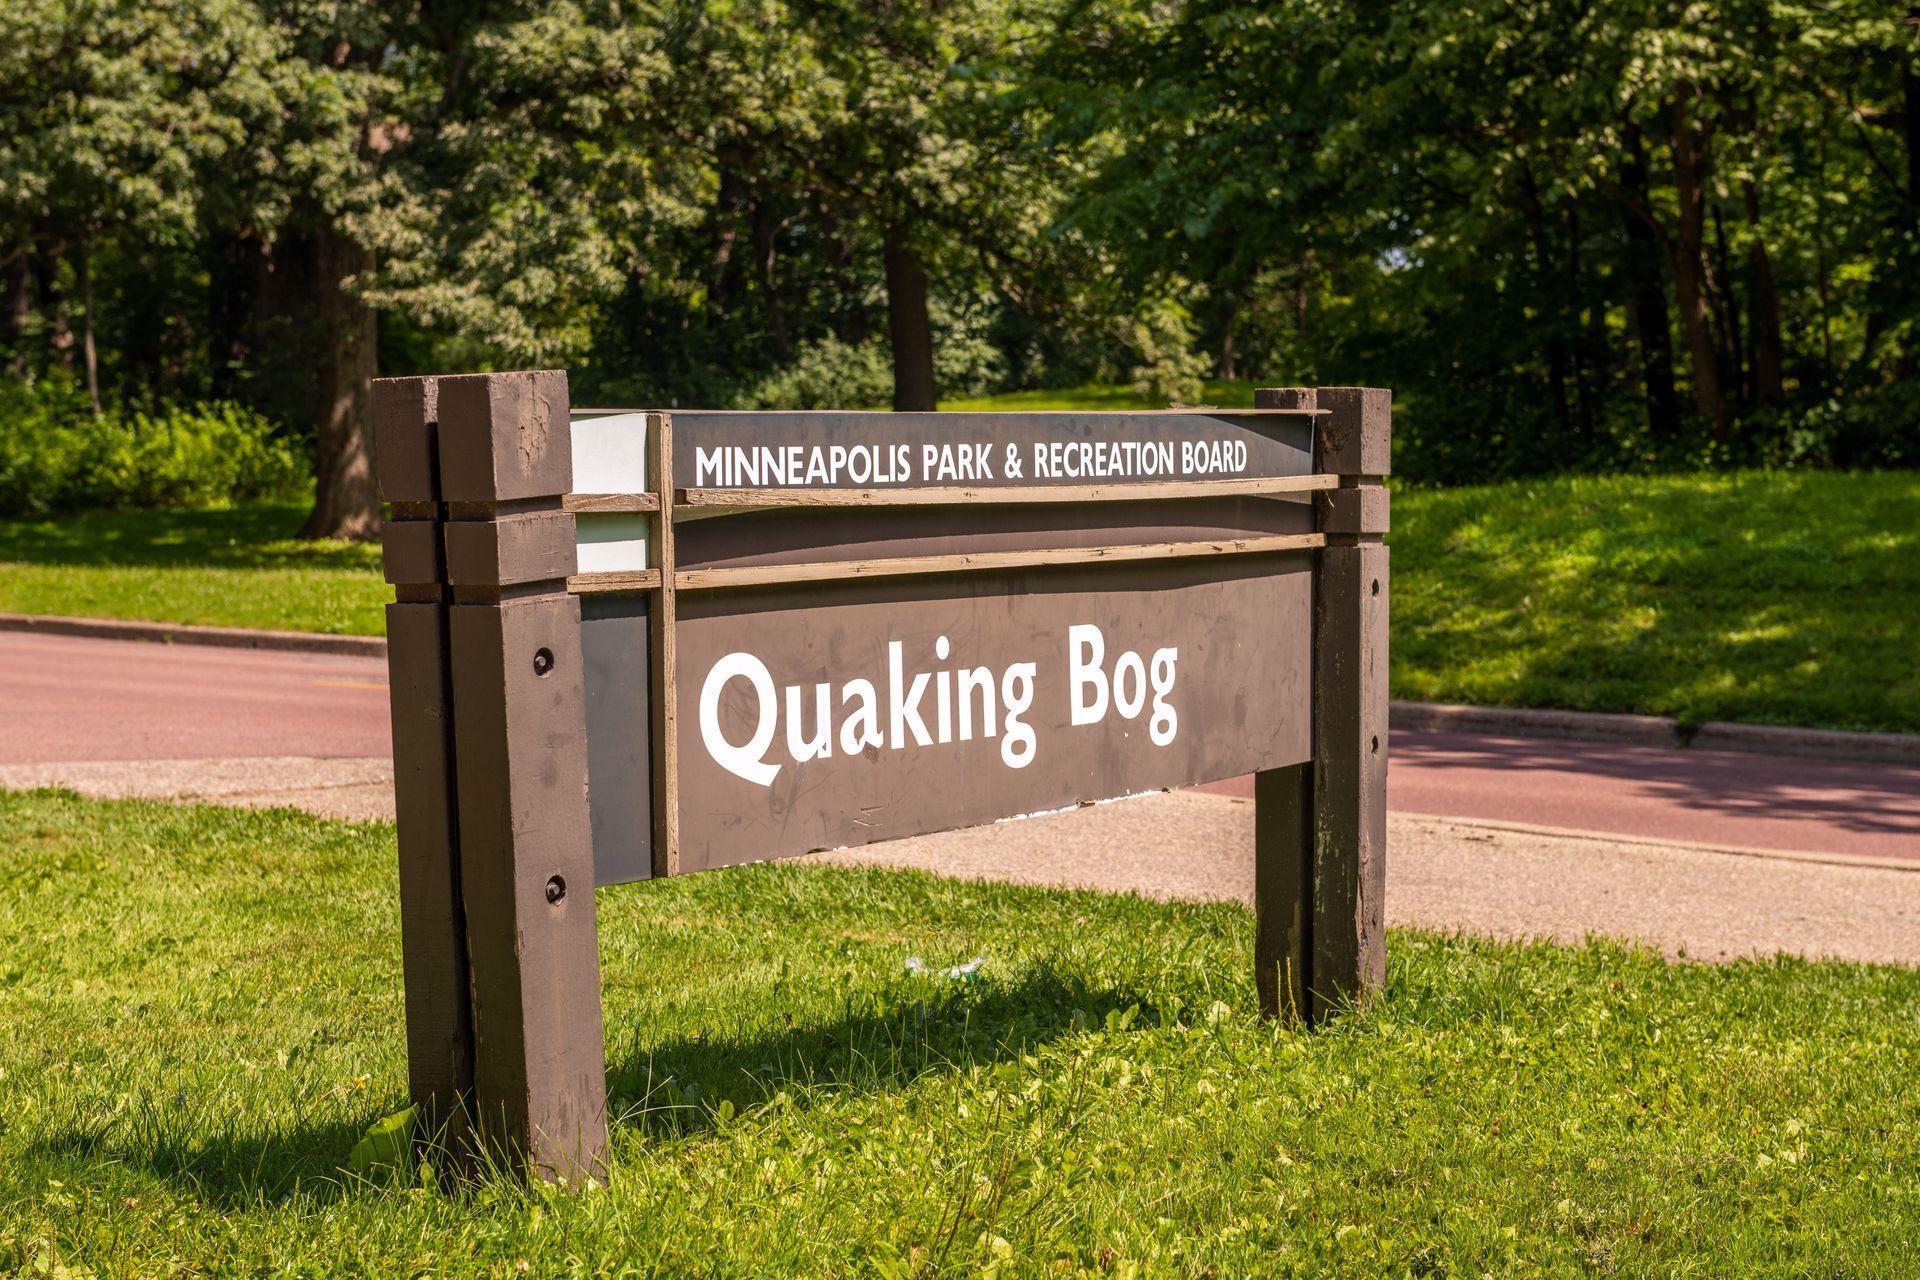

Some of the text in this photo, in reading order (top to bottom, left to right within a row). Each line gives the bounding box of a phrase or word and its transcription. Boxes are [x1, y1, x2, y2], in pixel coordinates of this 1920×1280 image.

[695, 439, 1248, 488] MINNEAPOLIS PARK & RECREATION BOARD
[698, 623, 1179, 788] Quaking Bog
